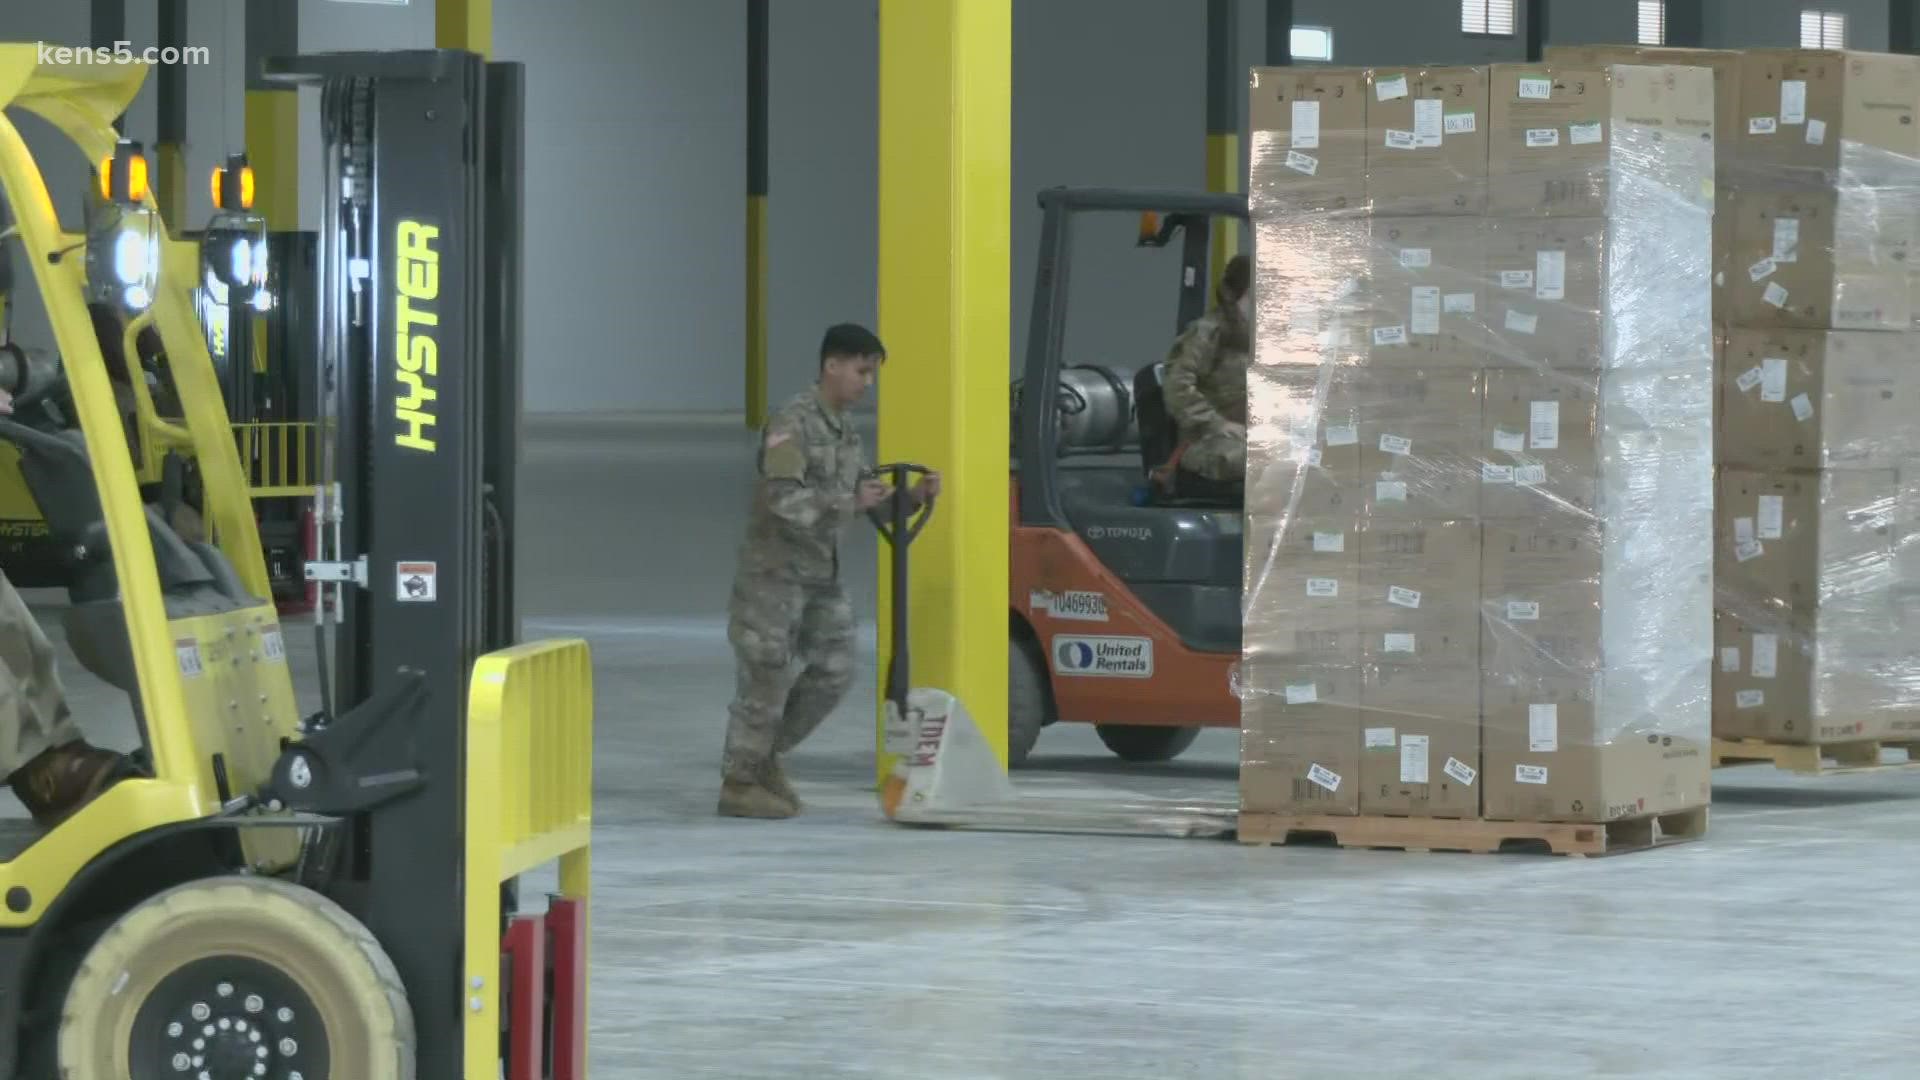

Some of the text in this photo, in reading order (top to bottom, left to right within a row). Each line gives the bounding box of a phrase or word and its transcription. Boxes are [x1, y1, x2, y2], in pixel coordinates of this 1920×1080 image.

[395, 220, 439, 452] HYSTER
[1107, 527, 1153, 540] TOYOTA
[1096, 642, 1142, 657] United
[1096, 657, 1146, 671] Rentals
